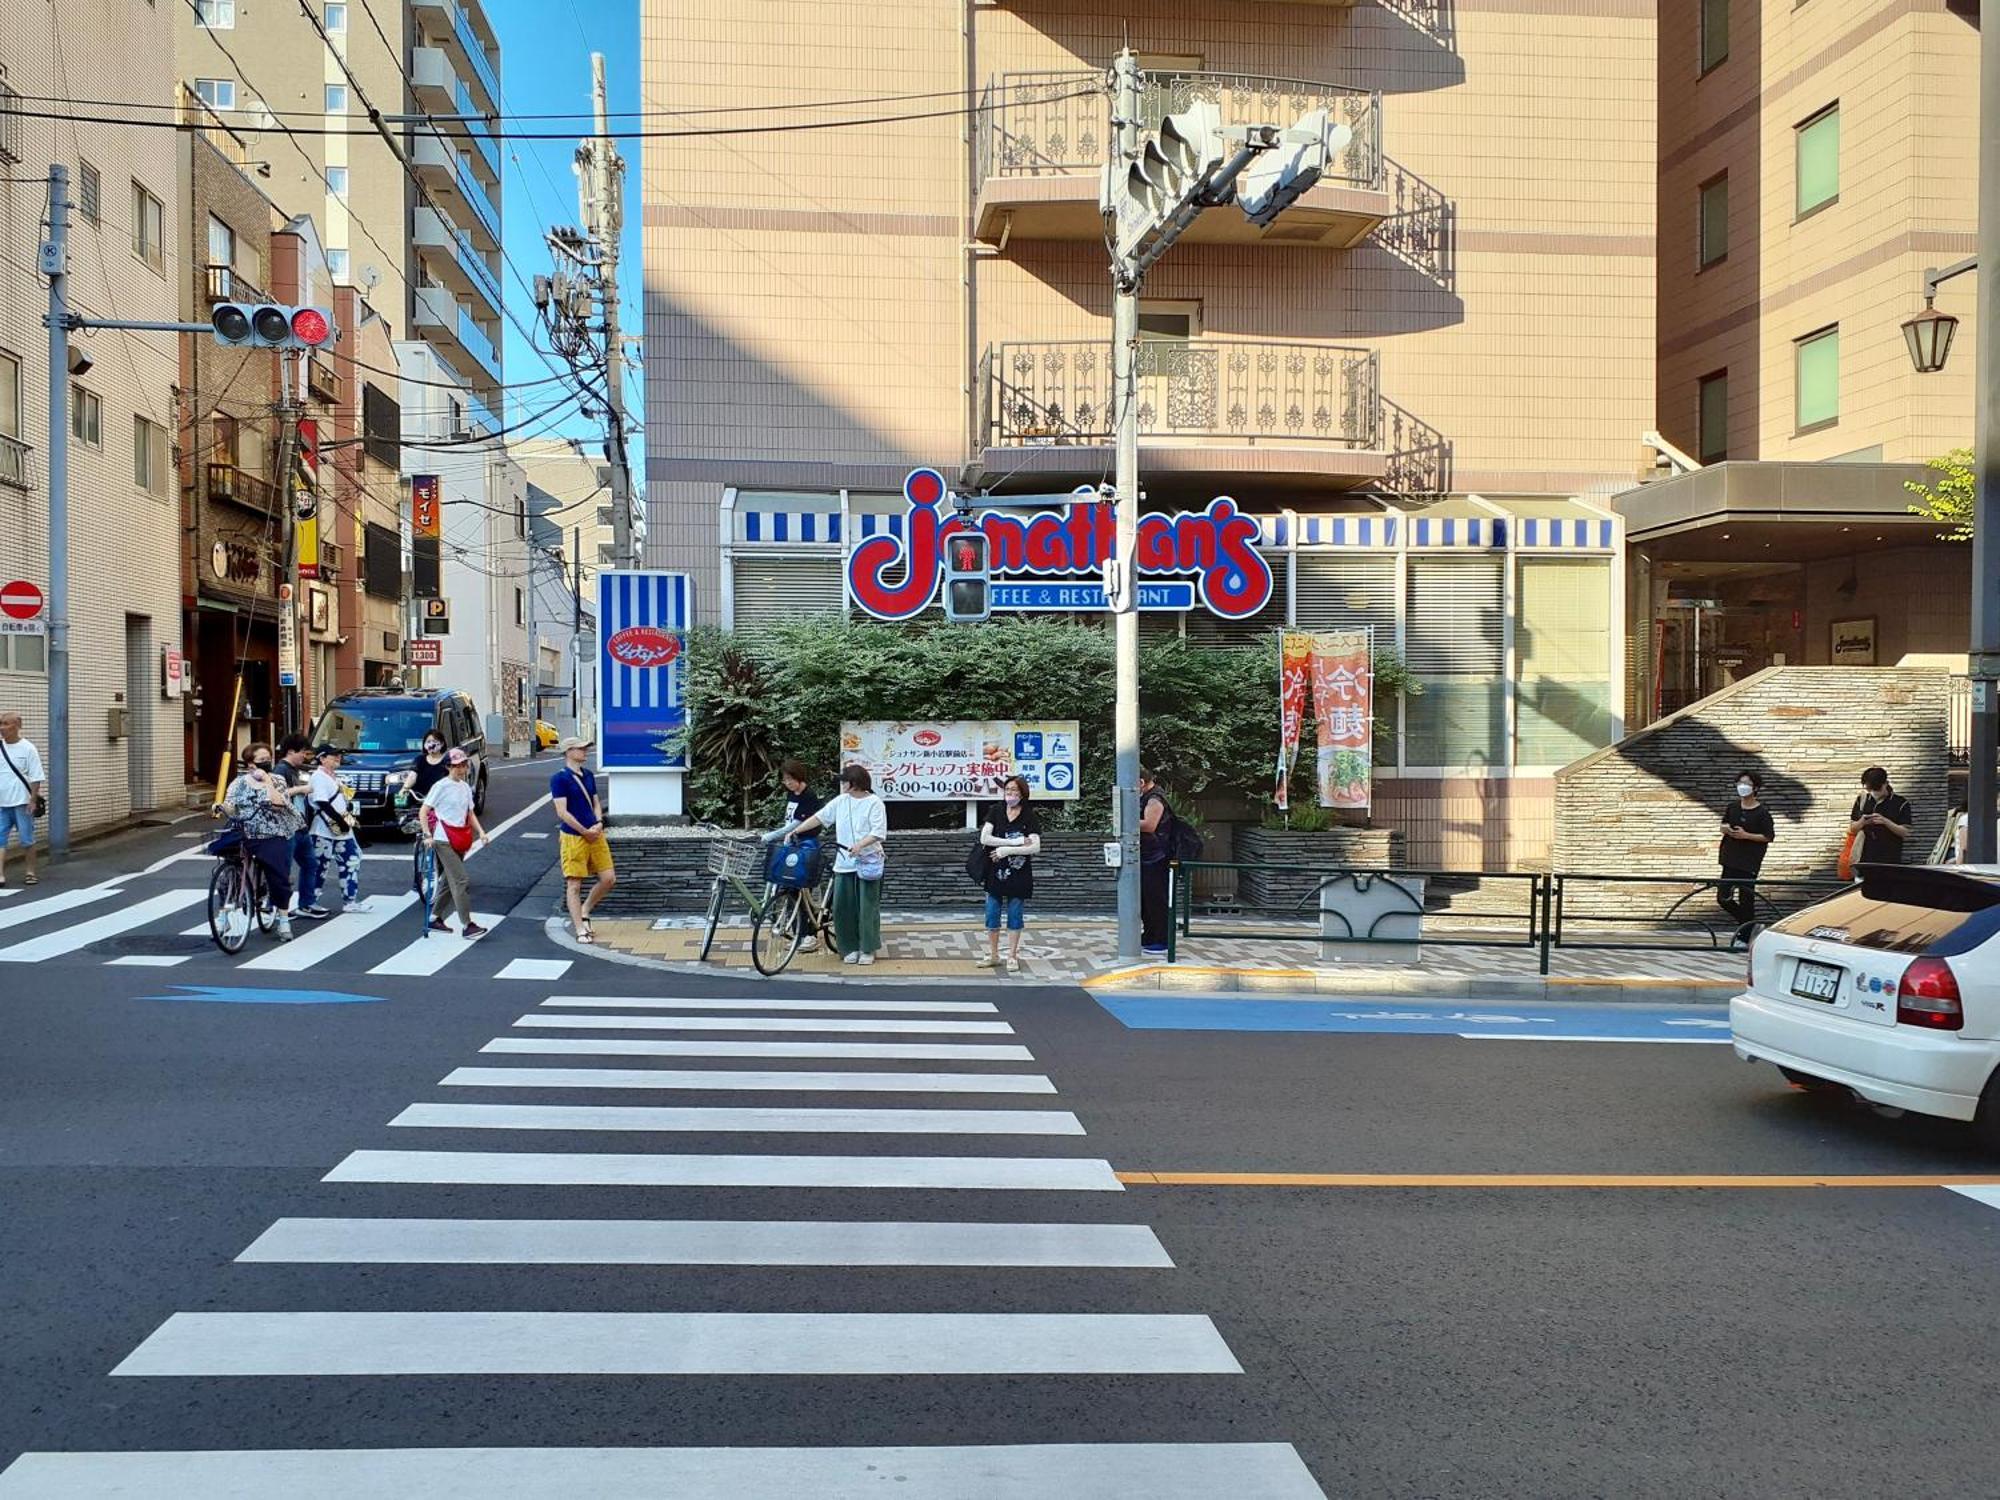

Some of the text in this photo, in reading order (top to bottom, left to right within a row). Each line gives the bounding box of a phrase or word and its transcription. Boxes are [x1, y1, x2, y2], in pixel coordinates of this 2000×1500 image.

[418, 488, 431, 525] モイセ
[991, 588, 1171, 604] FFEE & RESTANT
[430, 601, 443, 616] P
[845, 761, 1009, 777] ニングビュッフェ実施中
